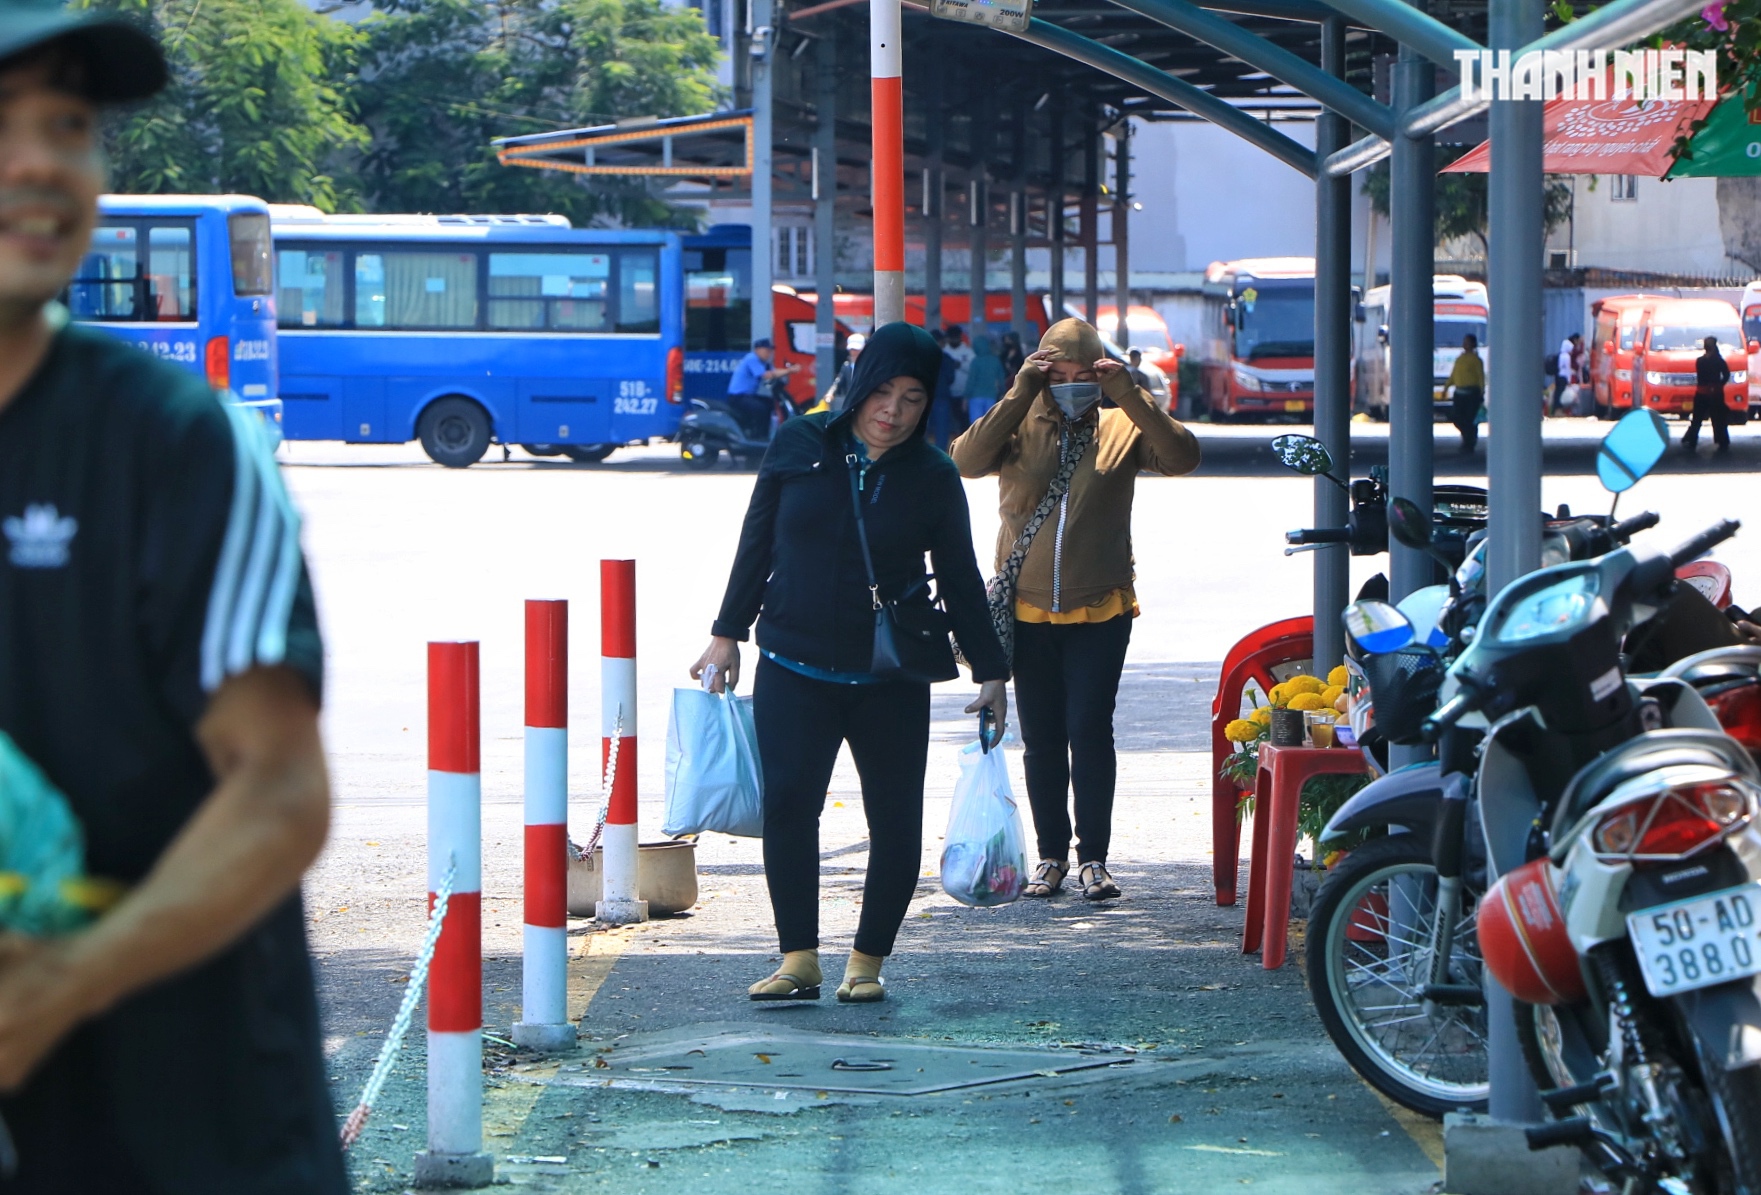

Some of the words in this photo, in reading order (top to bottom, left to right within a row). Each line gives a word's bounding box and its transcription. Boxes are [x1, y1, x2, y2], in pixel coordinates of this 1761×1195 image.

[945, 0, 969, 8] KITAWA
[1000, 9, 1024, 18] 200W
[614, 397, 659, 415] 242.27
[869, 486, 881, 505] MODEL
[1651, 894, 1754, 947] 50-AD
[1655, 935, 1757, 987] 388.0
